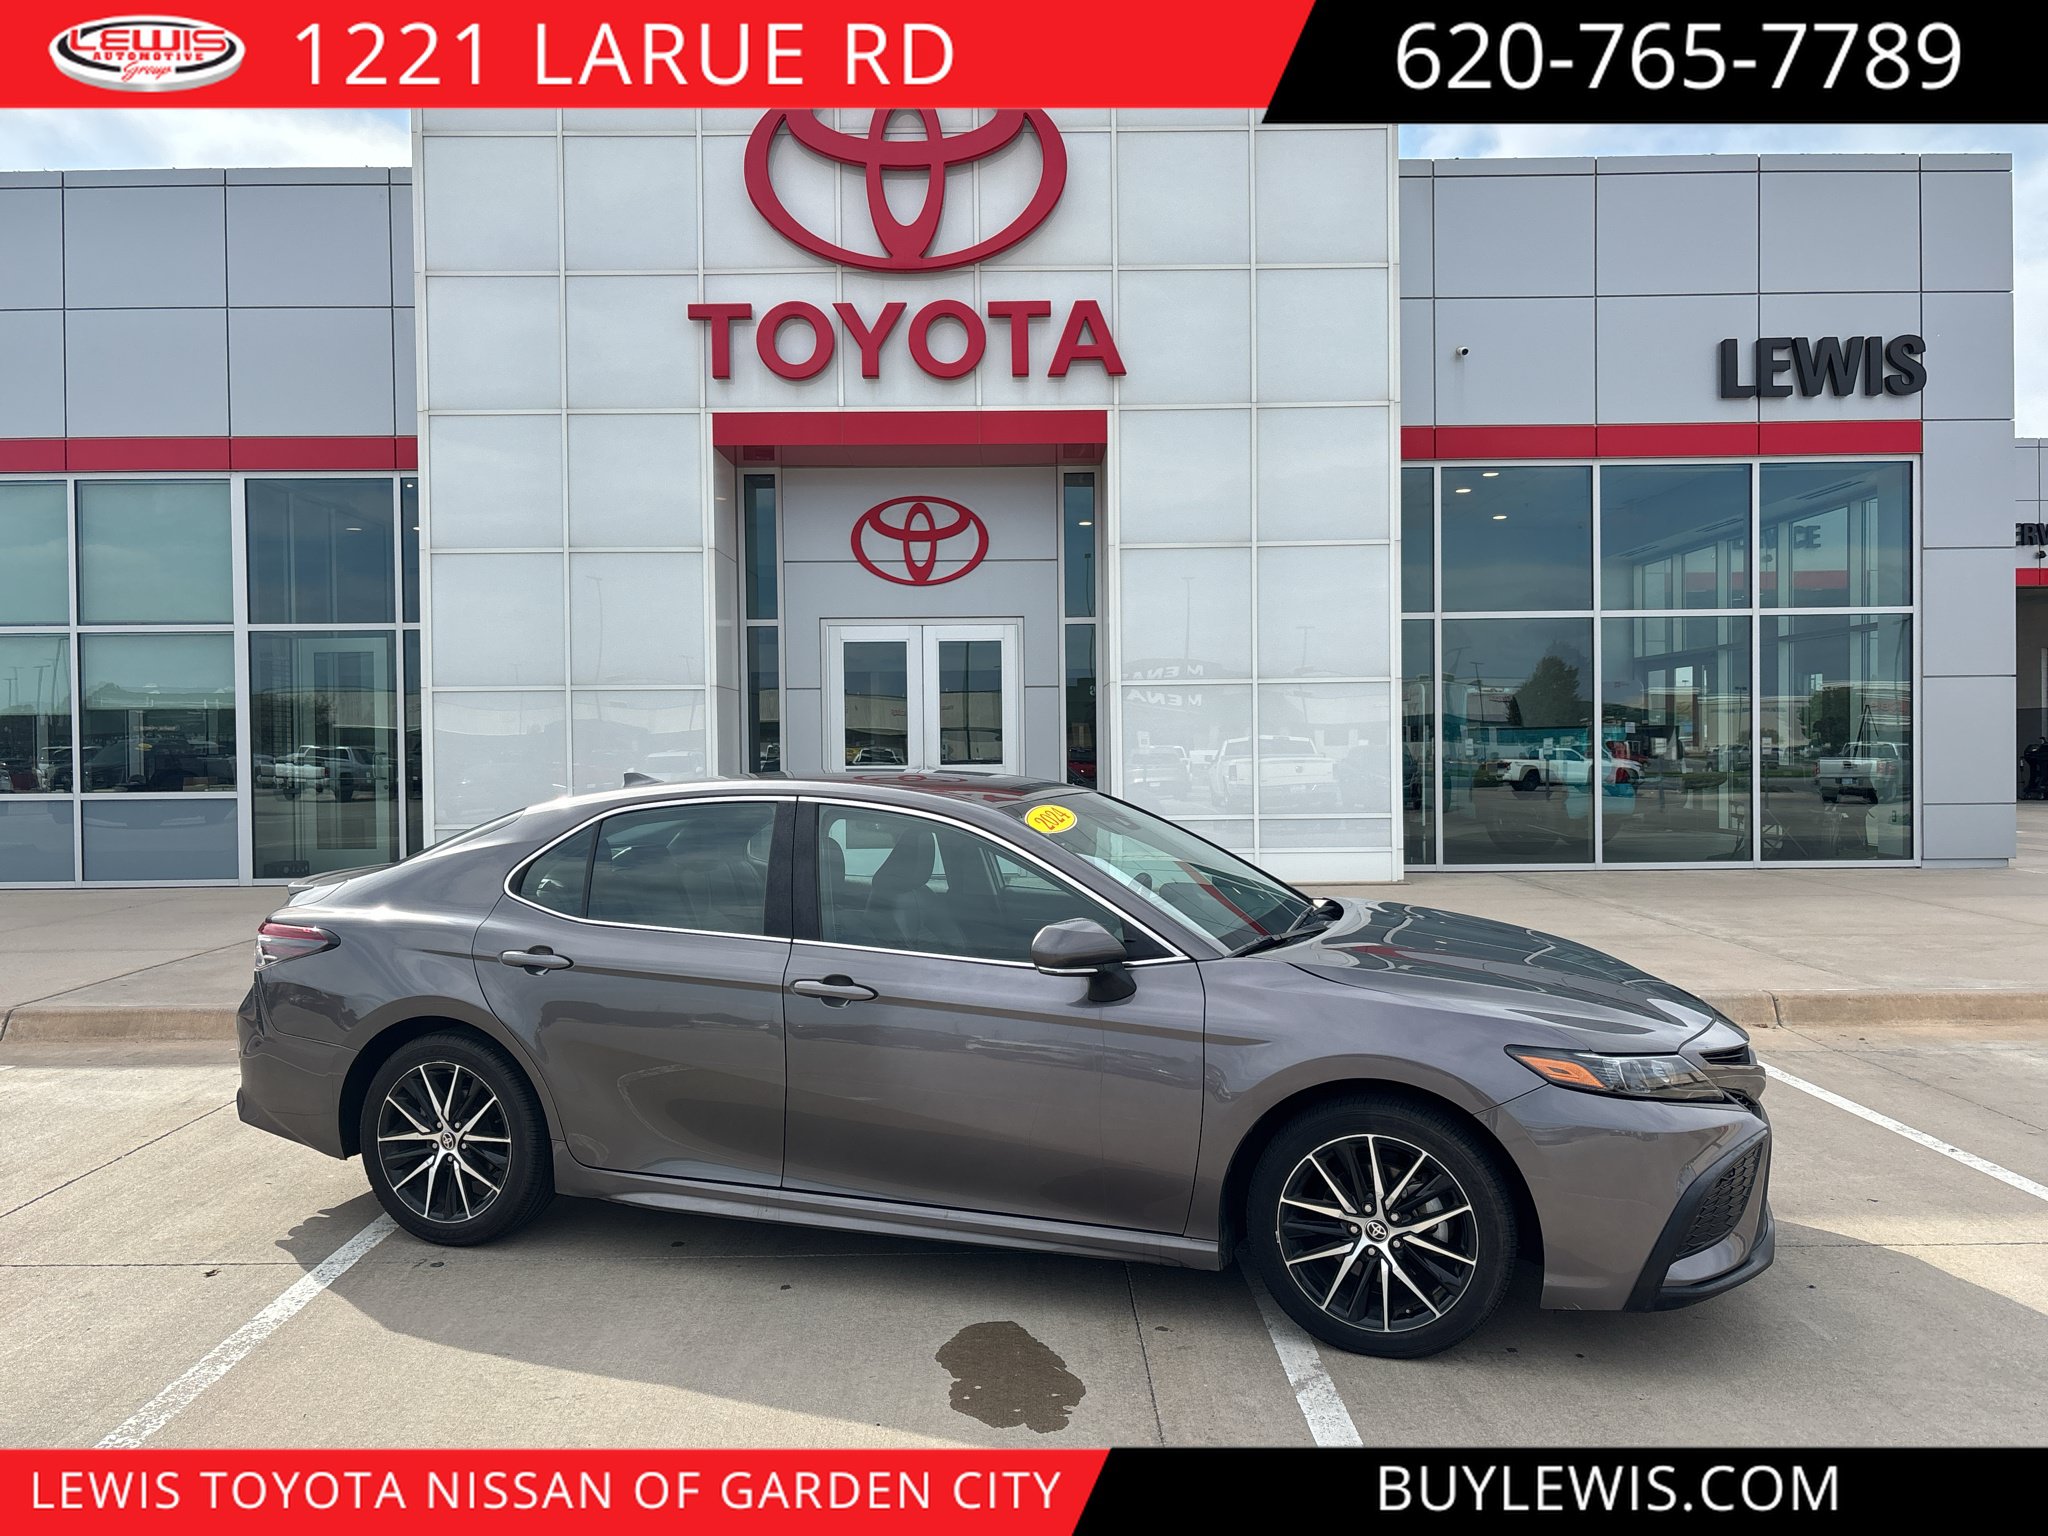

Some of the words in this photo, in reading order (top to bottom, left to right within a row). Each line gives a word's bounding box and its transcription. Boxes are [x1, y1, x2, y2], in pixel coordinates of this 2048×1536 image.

[688, 299, 1127, 380] TOYOTA
[1718, 334, 1928, 399] LEWIS
[1034, 806, 1071, 831] 2024
